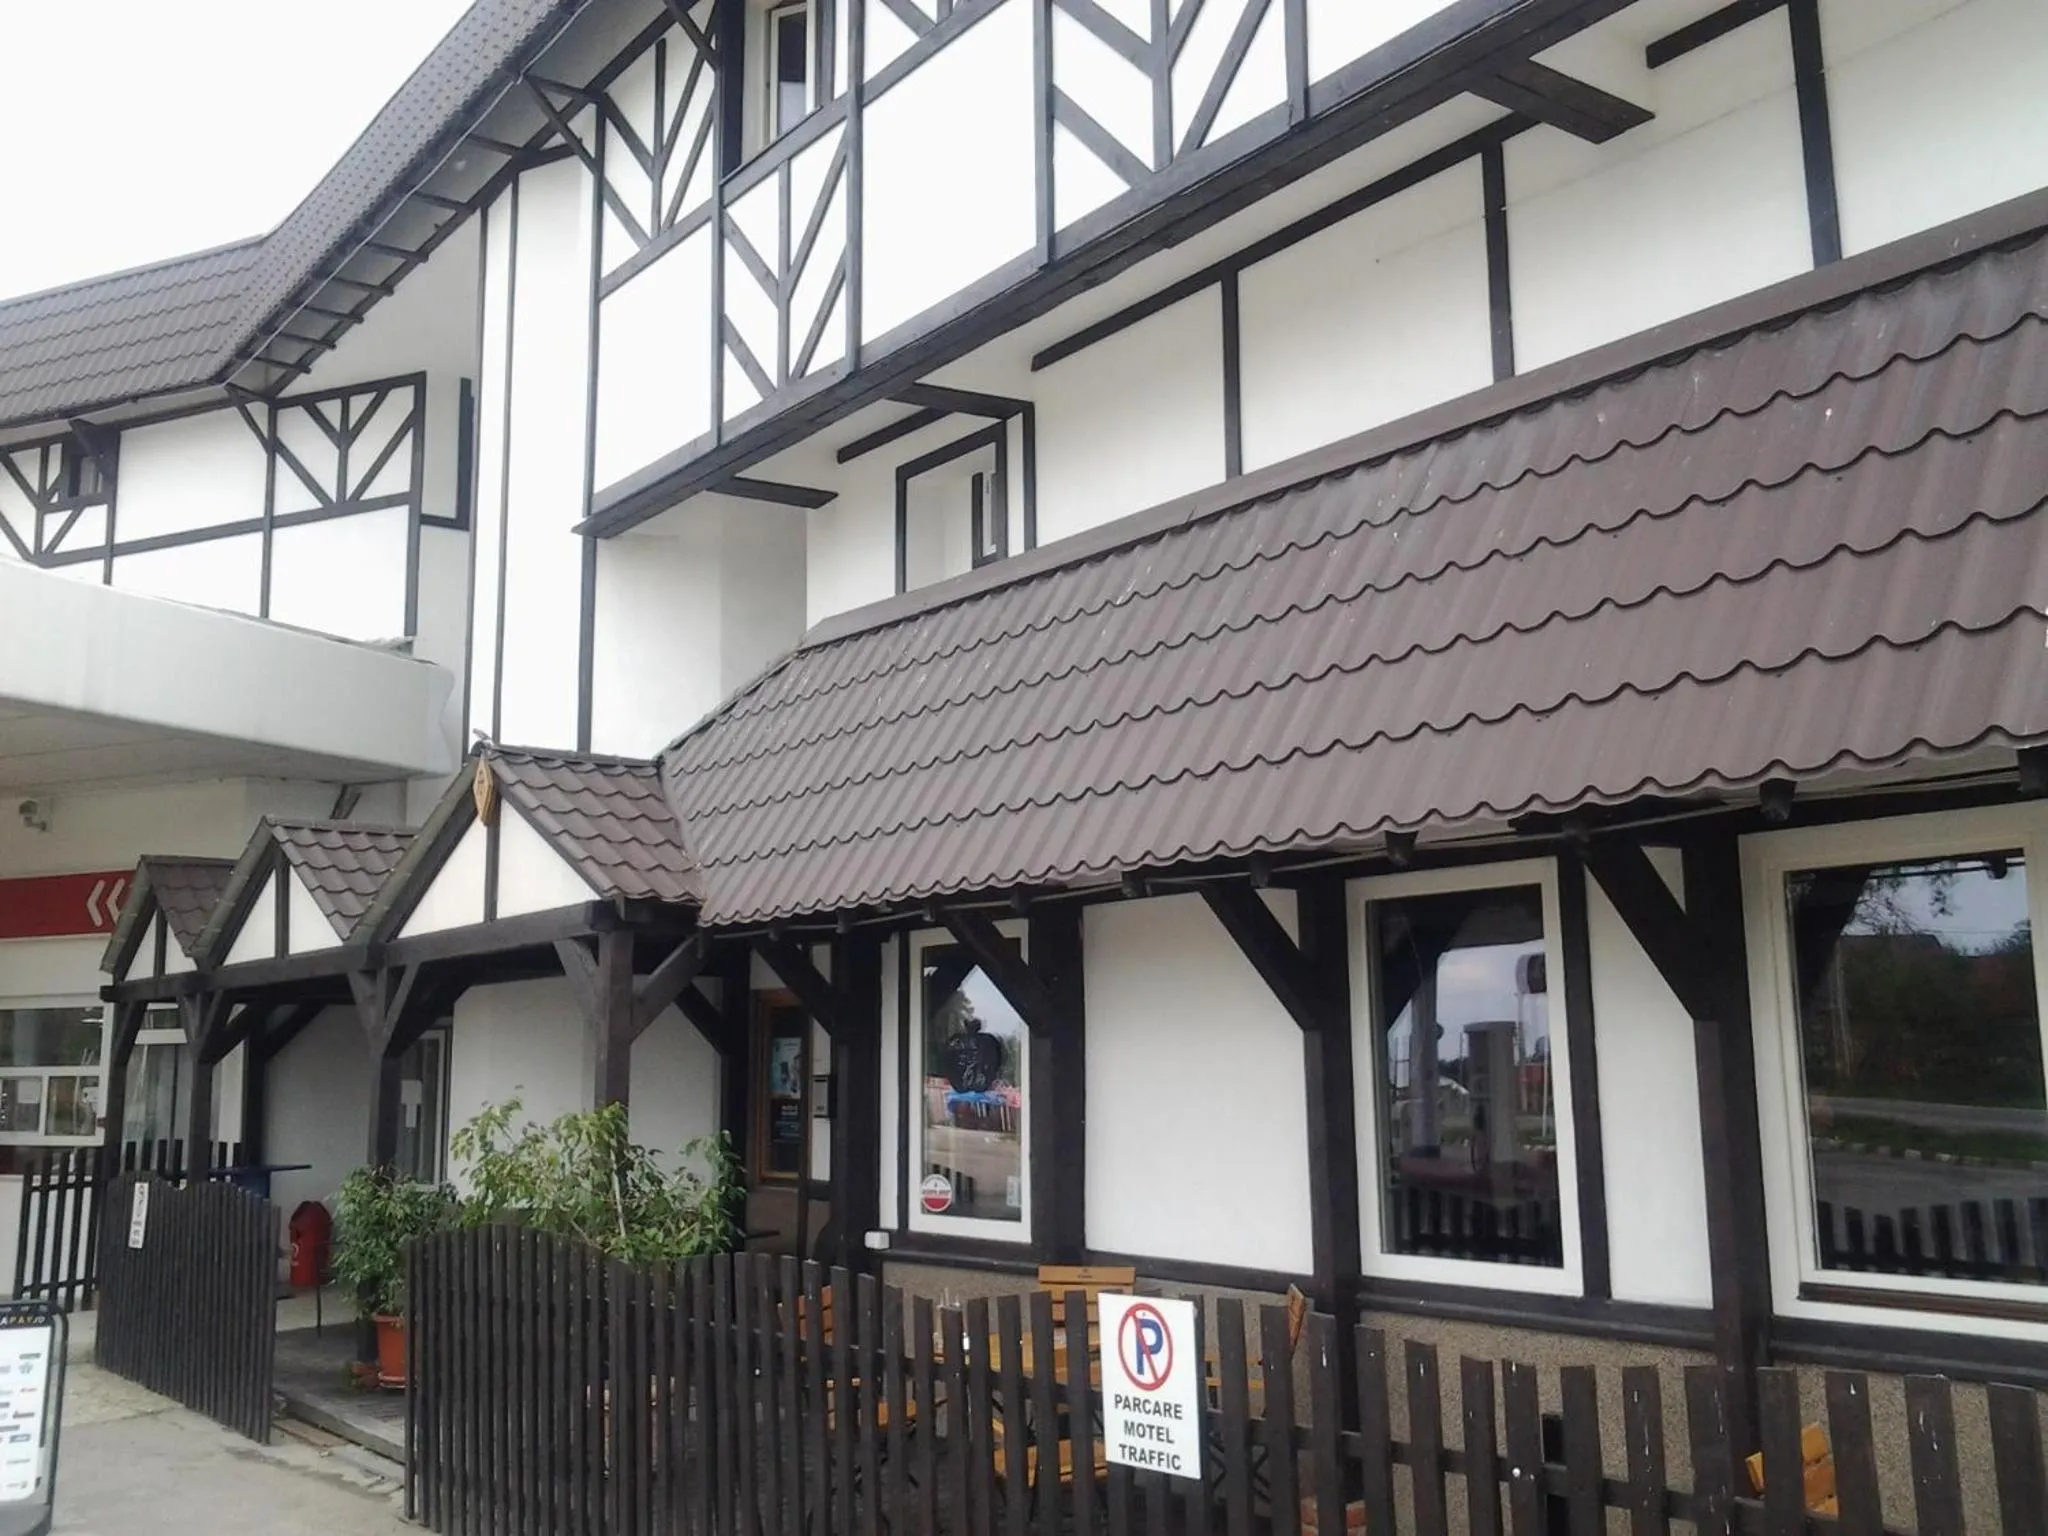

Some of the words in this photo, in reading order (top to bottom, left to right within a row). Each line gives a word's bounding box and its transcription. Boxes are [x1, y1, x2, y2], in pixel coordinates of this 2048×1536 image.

[1114, 1394, 1183, 1420] PARCARE
[1123, 1419, 1175, 1444] MOTEL
[1118, 1443, 1182, 1471] TRAFFIC
